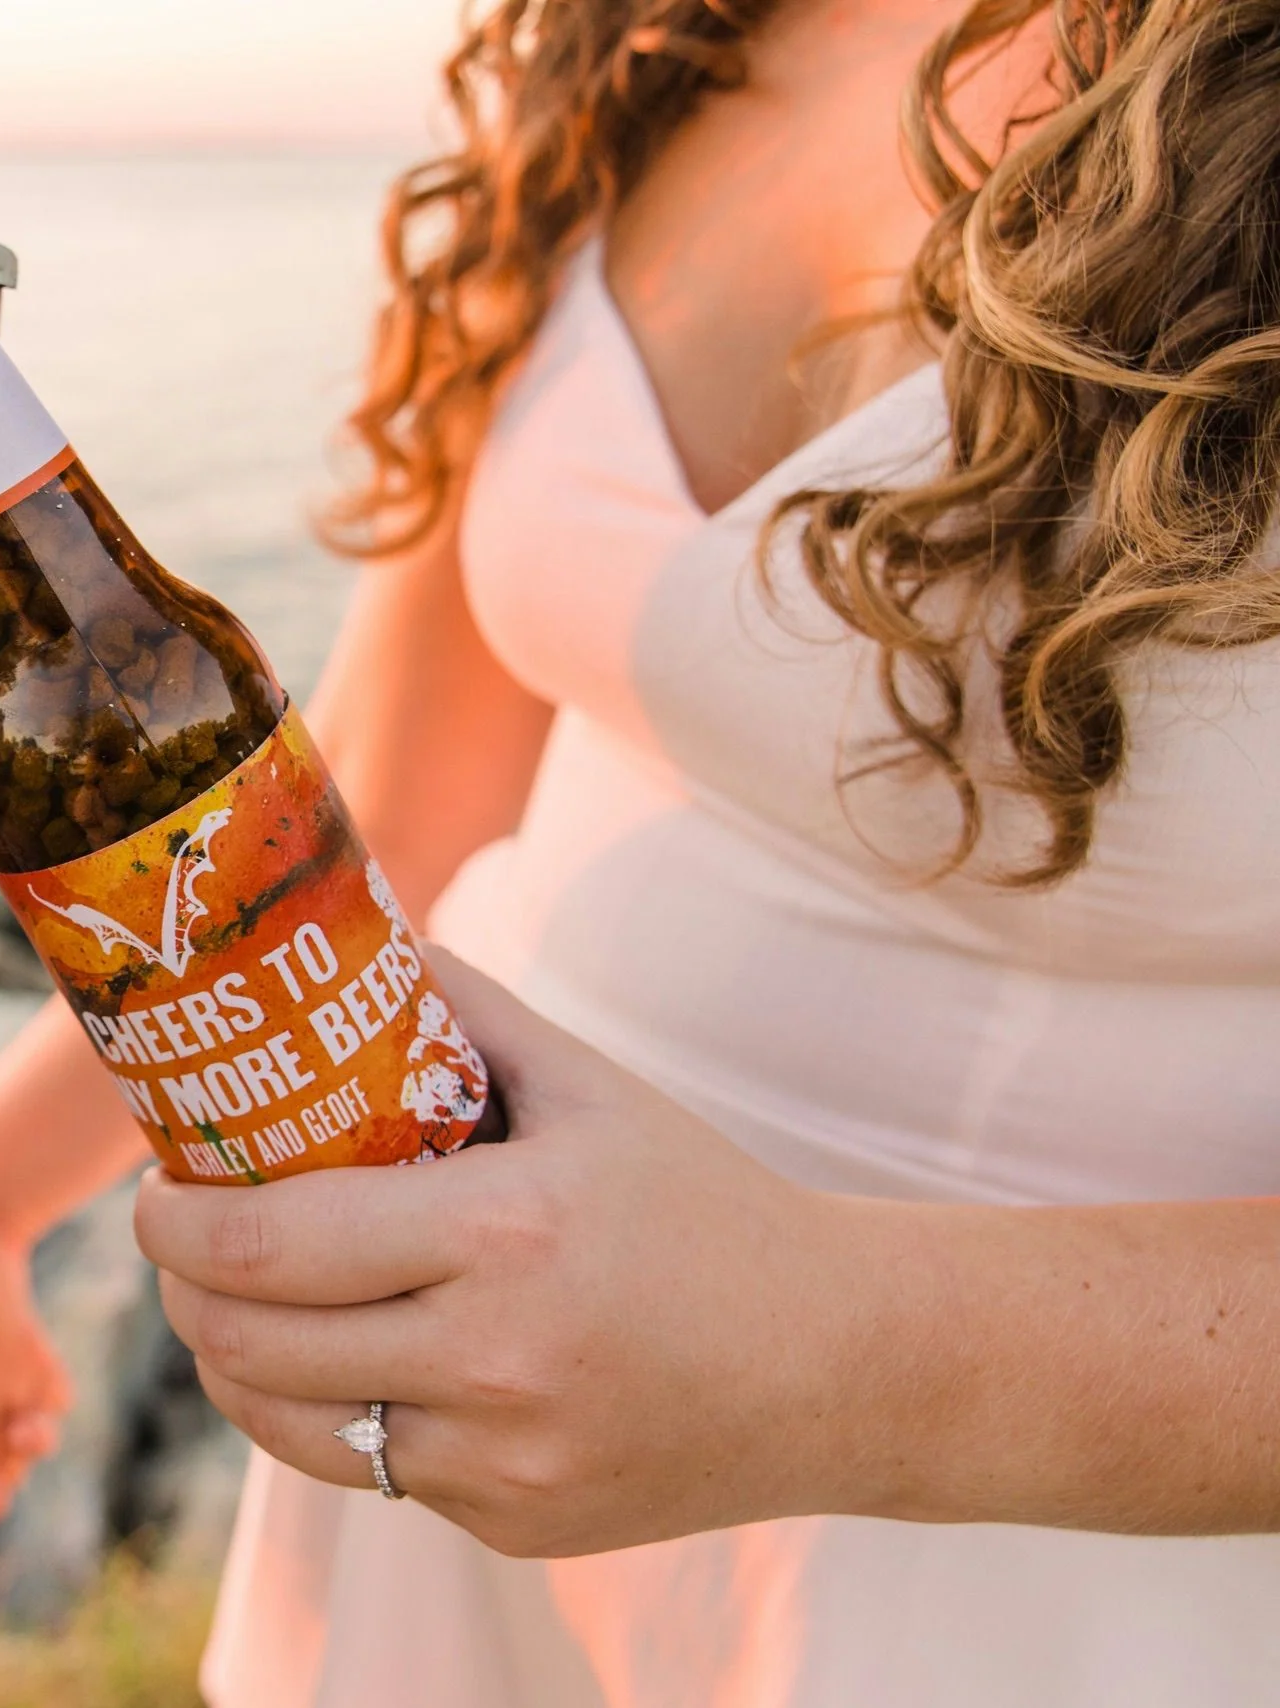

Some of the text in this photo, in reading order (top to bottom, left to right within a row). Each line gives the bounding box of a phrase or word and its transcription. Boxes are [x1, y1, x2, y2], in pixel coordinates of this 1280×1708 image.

[82, 921, 339, 1066] CHEERS TO
[113, 924, 422, 1128] NY MORE BEERS
[178, 1133, 257, 1178] ASHLEY
[251, 1116, 307, 1168] AND
[298, 1076, 373, 1145] GEOFF
